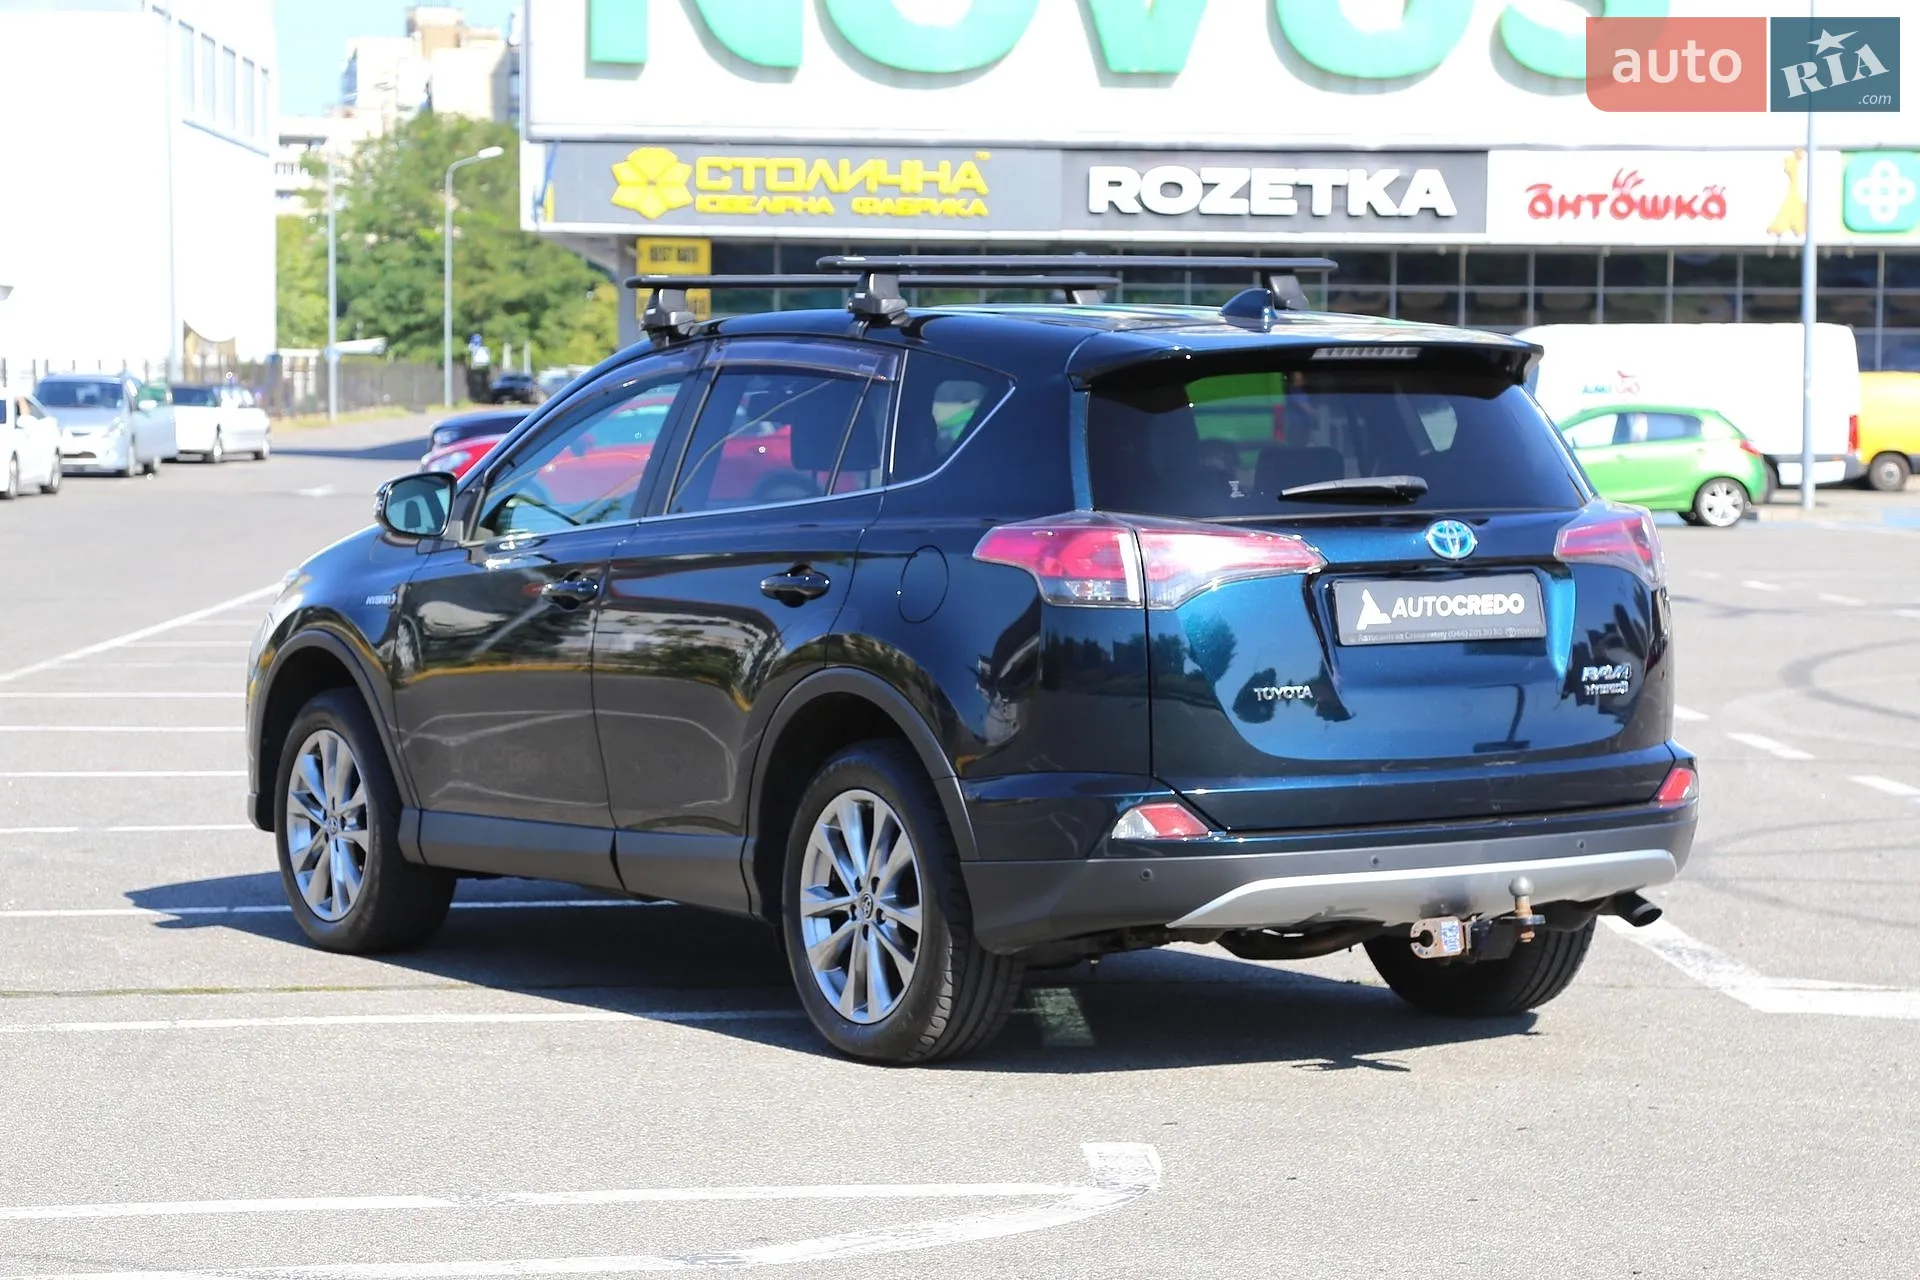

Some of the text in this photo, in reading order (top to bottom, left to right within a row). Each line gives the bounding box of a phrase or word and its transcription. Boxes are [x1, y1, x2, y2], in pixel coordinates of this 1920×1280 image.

[695, 156, 989, 195] СТОЛИЧНА
[1088, 165, 1457, 216] ROZETKA
[1392, 593, 1525, 618] AUTOCREDO
[1253, 685, 1313, 701] TOYOTA
